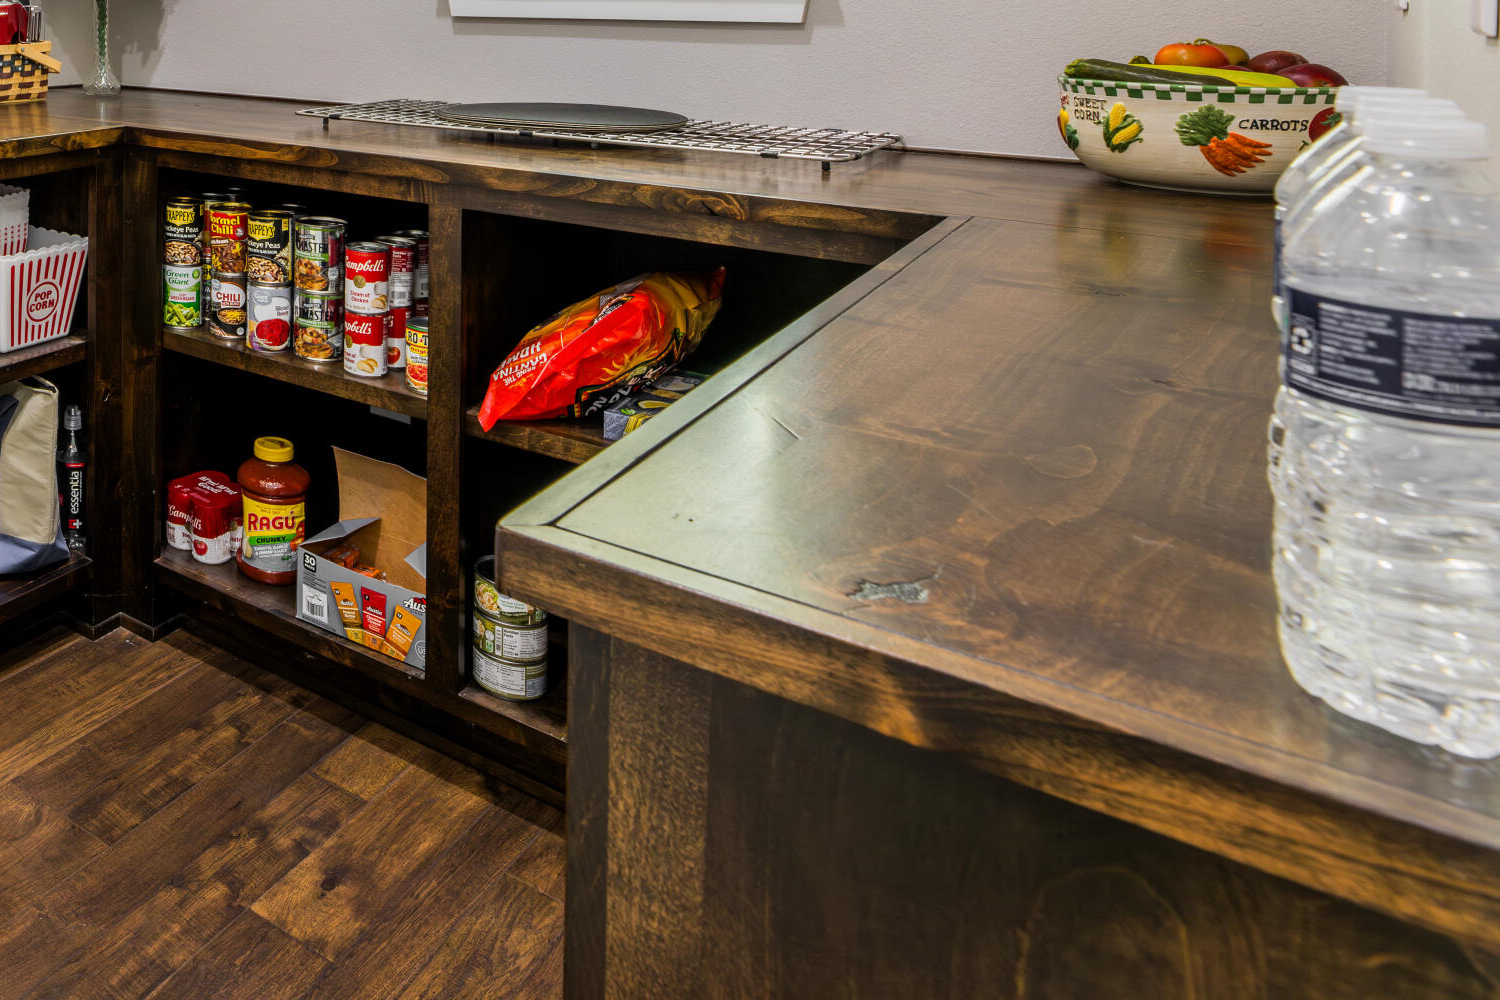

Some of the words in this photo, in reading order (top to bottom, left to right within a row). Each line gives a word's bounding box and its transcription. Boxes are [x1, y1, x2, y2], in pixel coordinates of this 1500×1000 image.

[1074, 96, 1107, 110] SWEET
[1074, 109, 1100, 121] CORN
[1238, 118, 1309, 132] CARROTS
[211, 215, 240, 225] ormel
[211, 223, 234, 235] Chili
[264, 241, 281, 249] Peas
[166, 270, 189, 278] Green
[168, 278, 189, 286] Giant
[34, 290, 53, 302] POP
[216, 291, 241, 302] CHILI
[29, 299, 54, 313] CORN
[70, 470, 80, 515] essentia
[247, 511, 296, 532] RAGÚ
[256, 536, 286, 544] CHUNKY
[304, 553, 316, 566] 30
